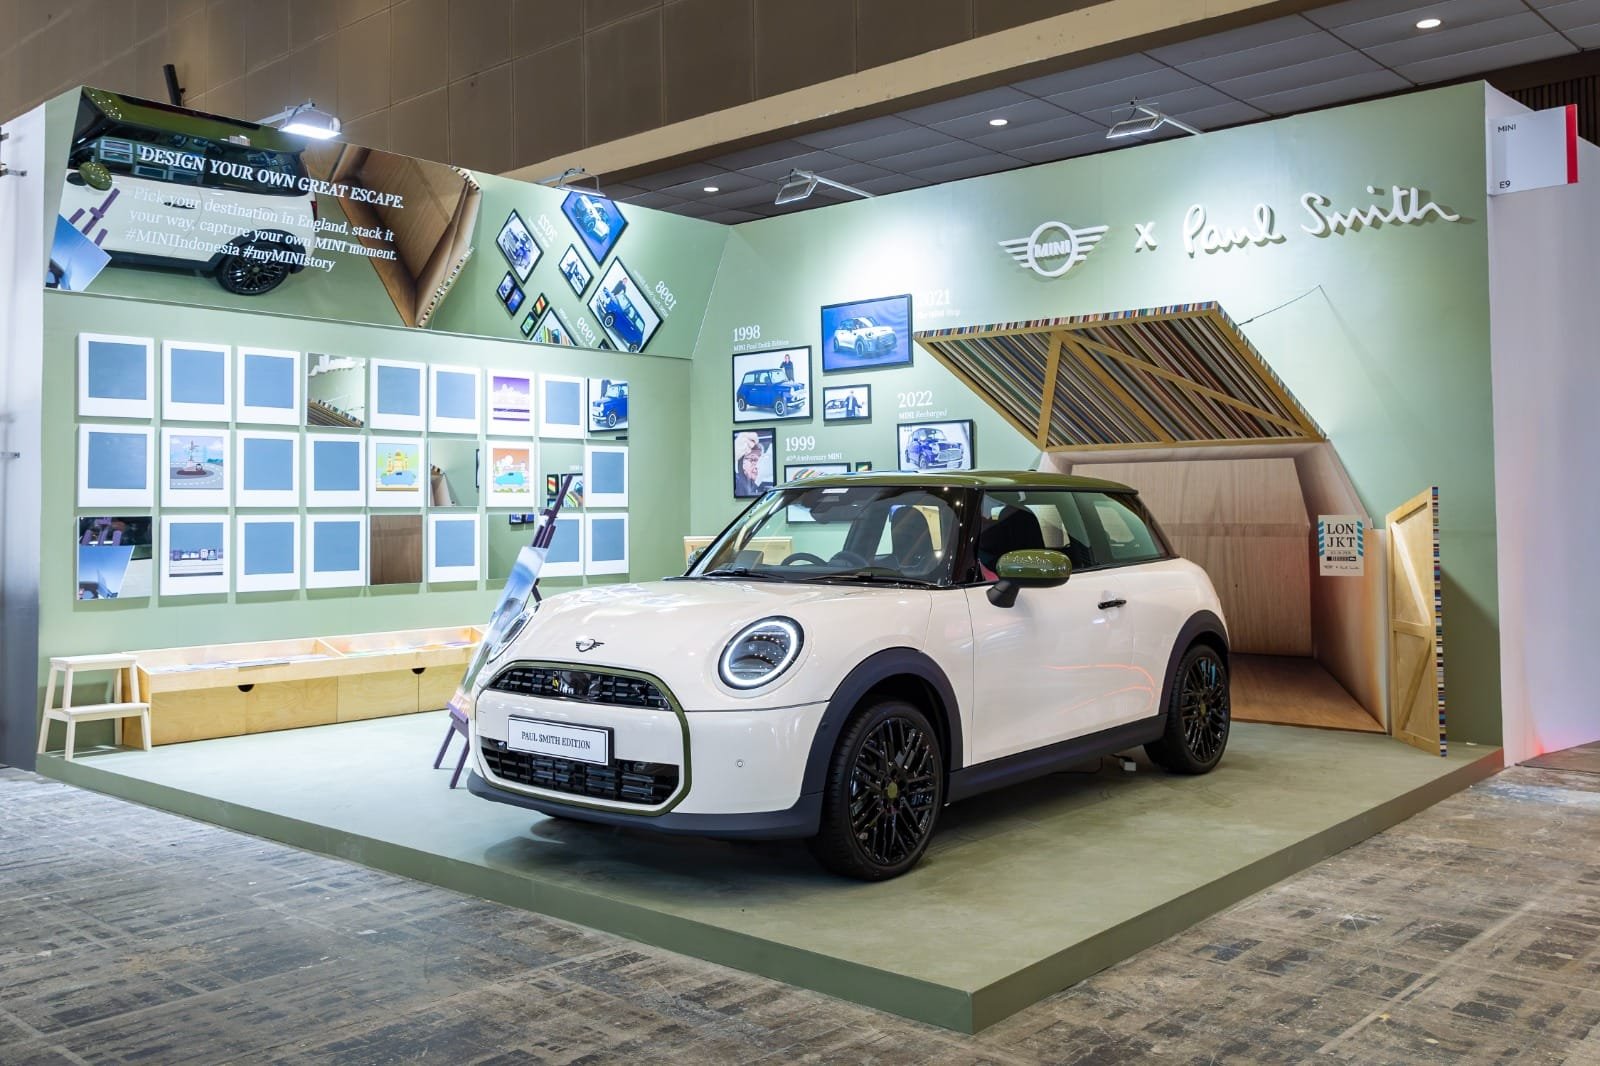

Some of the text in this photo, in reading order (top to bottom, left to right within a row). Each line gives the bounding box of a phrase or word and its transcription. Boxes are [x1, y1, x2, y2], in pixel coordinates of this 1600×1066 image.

[1497, 124, 1517, 133] MINI
[141, 146, 404, 209] DESIGN YOUR OWN GREAT ESCAPE.
[1499, 180, 1511, 189] E9
[134, 187, 395, 242] Pick your destination in England, stack it
[1034, 239, 1071, 258] MINI
[1183, 204, 1284, 255] Paul
[1300, 185, 1461, 235] Smith
[129, 210, 397, 261] your way, capture your own MINI moment.
[126, 228, 336, 272] #MINIIndonesia #myMINIstory
[919, 288, 951, 306] 021
[733, 325, 761, 342] 1998
[897, 390, 933, 409] 2022
[785, 435, 816, 452] 1999
[1326, 523, 1355, 535] LON
[1327, 536, 1356, 548] JKT
[521, 731, 591, 749] PAUL SMITH EDITION
